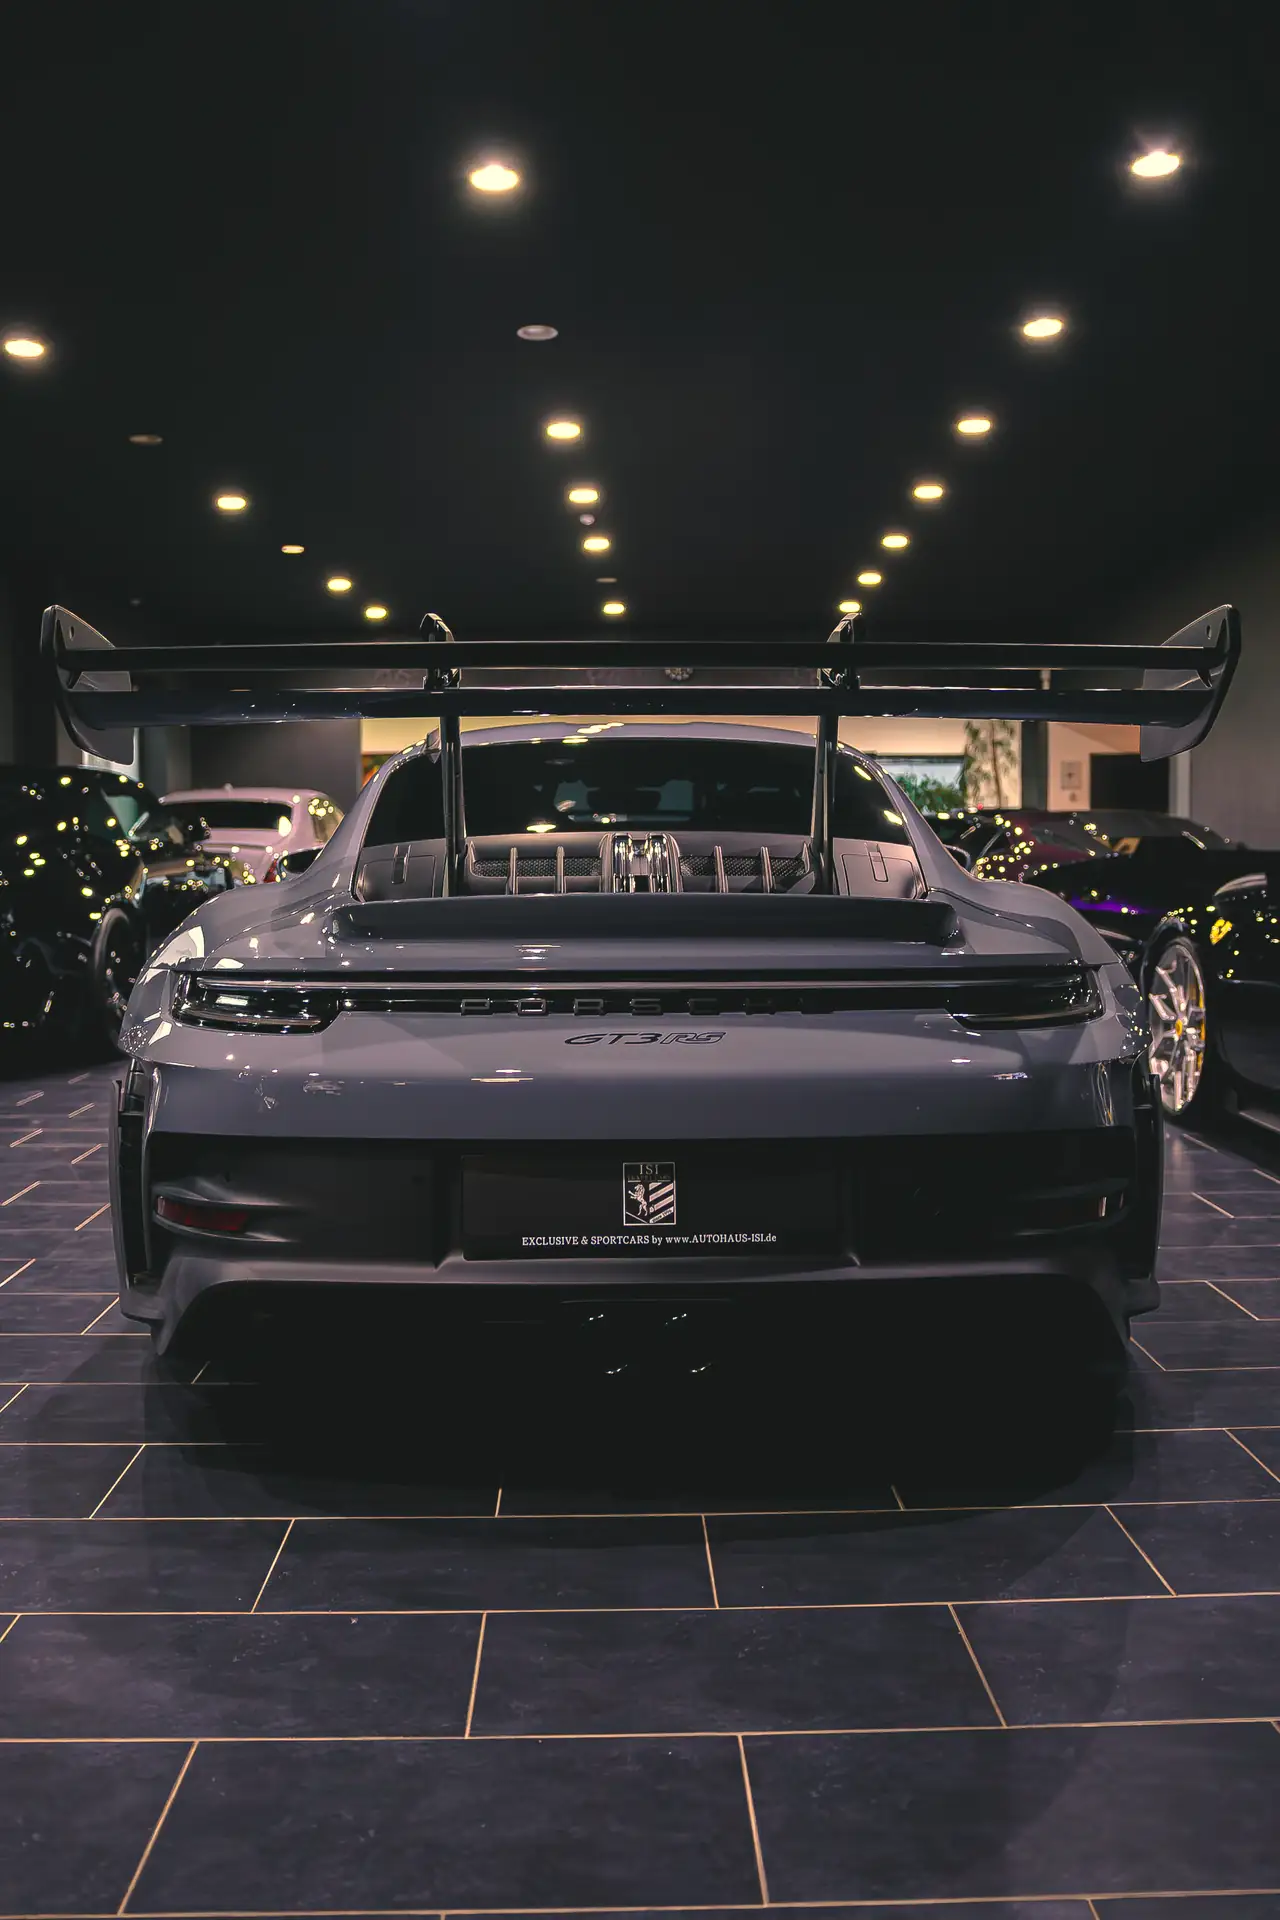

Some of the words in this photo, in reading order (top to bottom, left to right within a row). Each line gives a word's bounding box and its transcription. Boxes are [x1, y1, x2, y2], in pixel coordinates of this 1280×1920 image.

[461, 998, 833, 1016] PORSCH
[639, 1164, 659, 1175] ISI
[522, 1236, 579, 1246] EXCLUSIVE
[580, 1236, 589, 1245] &
[590, 1235, 650, 1245] SPORTCARS
[652, 1235, 663, 1246] by
[665, 1233, 777, 1244] www.AUTOHAUS-ISI.de
